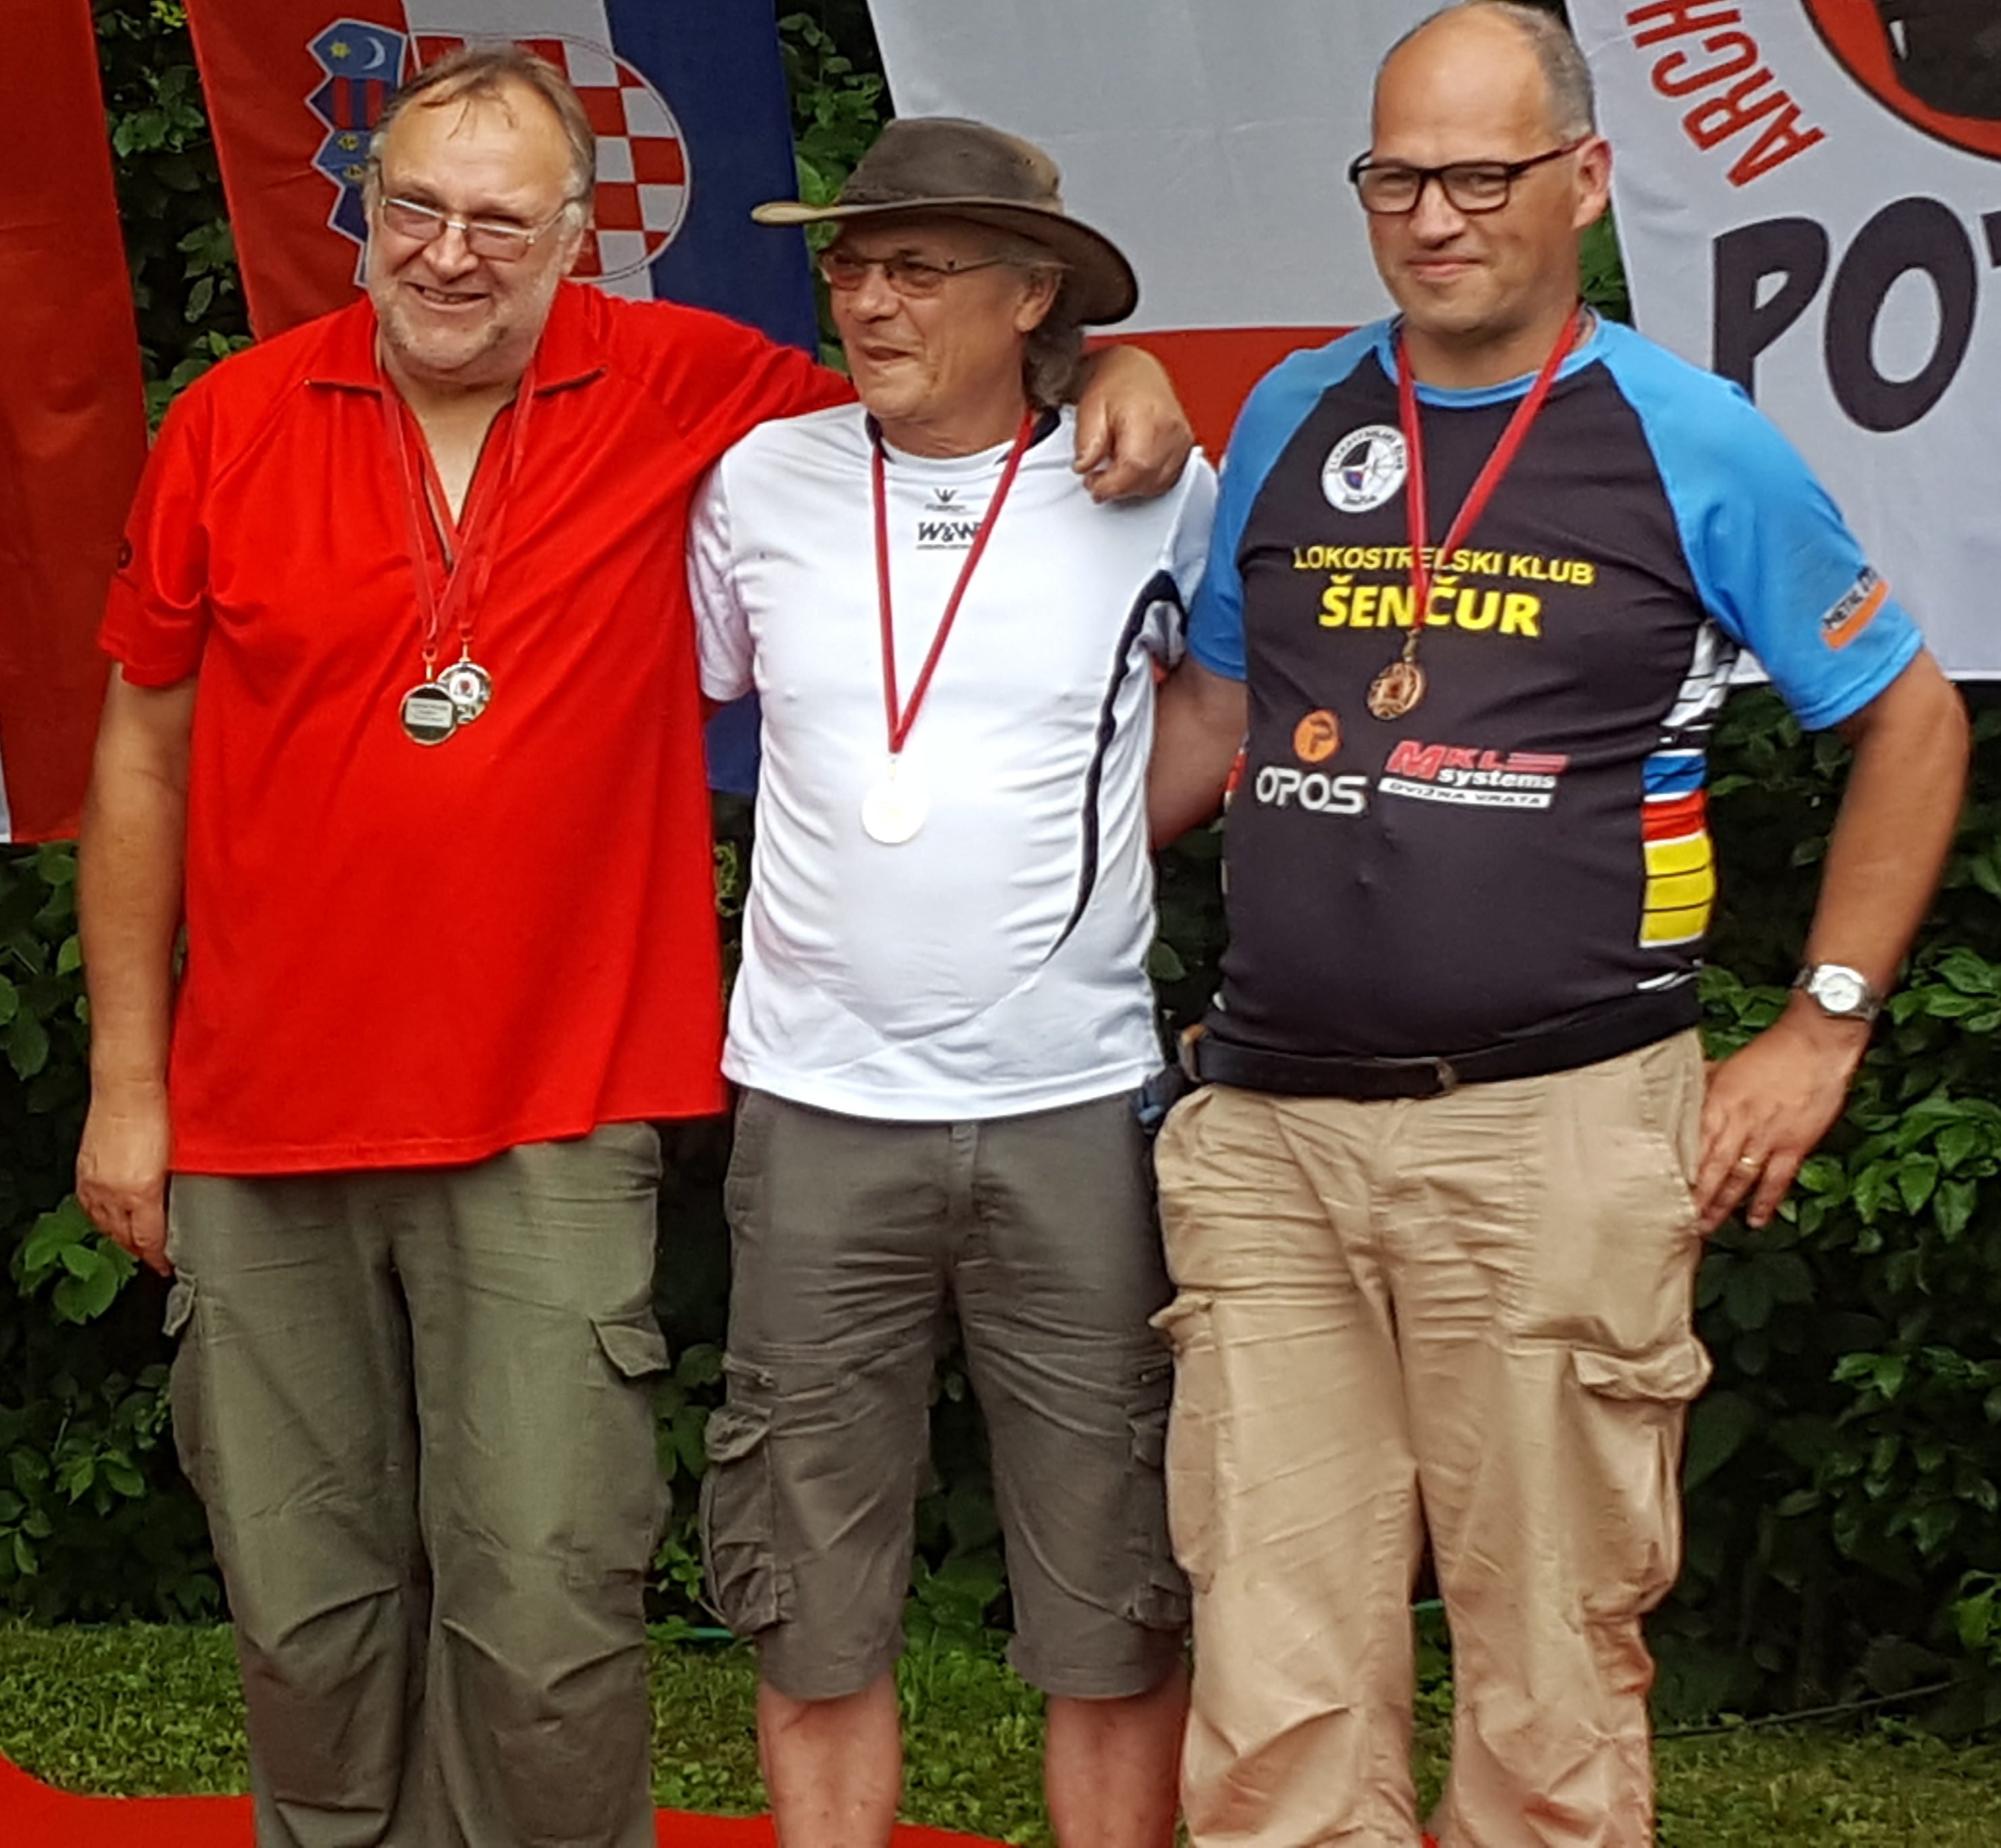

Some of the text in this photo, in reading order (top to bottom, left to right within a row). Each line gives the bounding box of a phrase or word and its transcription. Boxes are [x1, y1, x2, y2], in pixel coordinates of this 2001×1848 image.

[1712, 196, 2001, 432] PO
[1293, 545, 1596, 586] LOKOSTRELSKI KLUB
[1318, 574, 1542, 637] ŠENČUR
[1385, 740, 1508, 781] MKL
[1437, 768, 1556, 789] systems
[1256, 766, 1368, 814] OPOS
